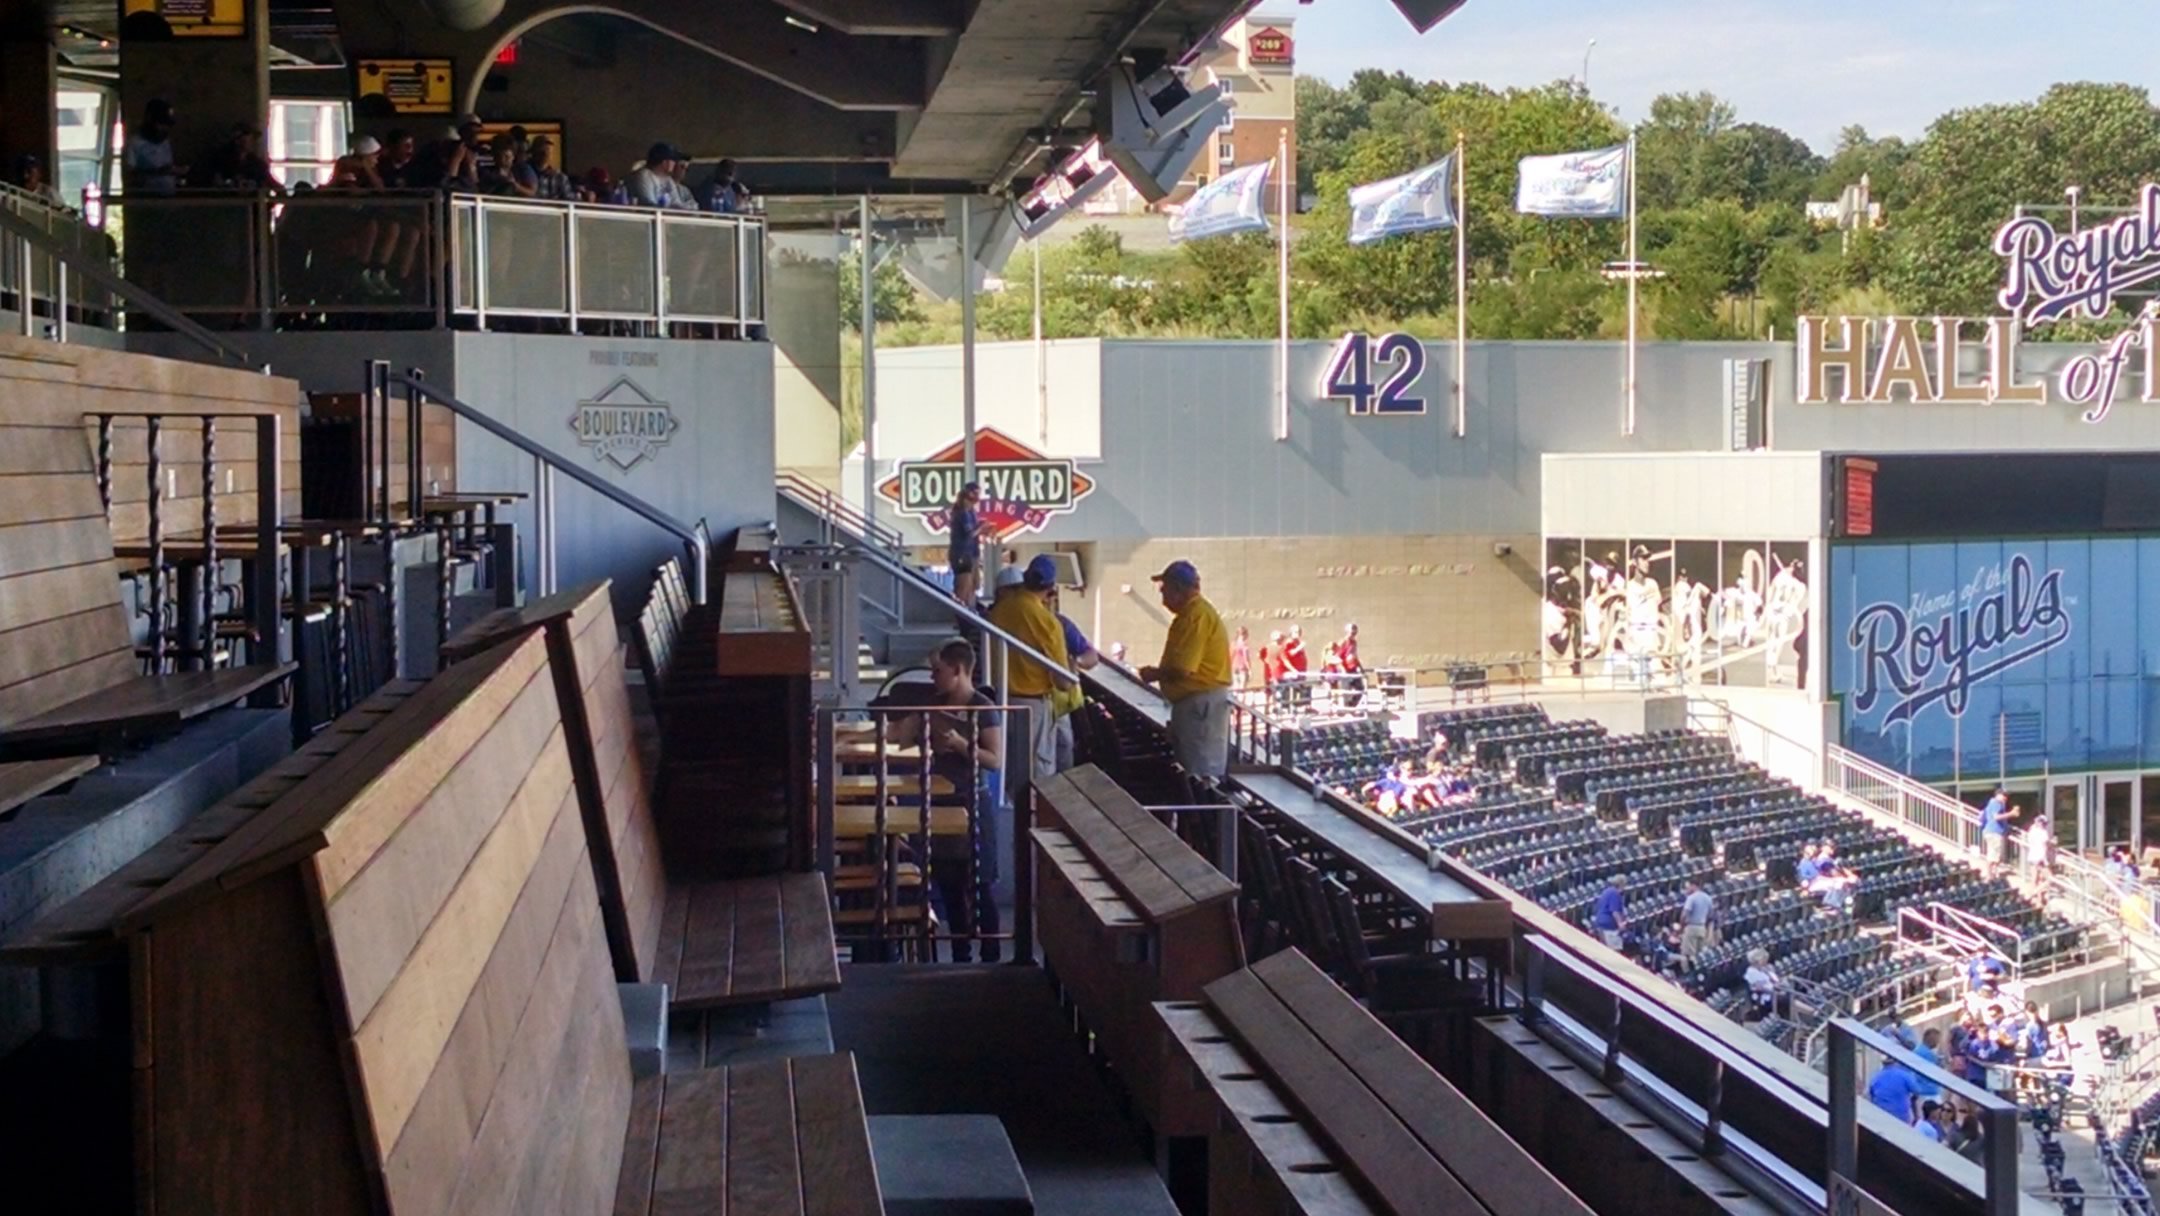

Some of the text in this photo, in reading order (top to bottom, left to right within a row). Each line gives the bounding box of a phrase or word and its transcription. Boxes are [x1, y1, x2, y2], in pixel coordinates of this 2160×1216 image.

[1320, 332, 1426, 415] 42
[1797, 315, 2046, 405] HALL
[2060, 330, 2142, 422] of
[583, 410, 666, 437] BOULEVARD
[908, 468, 1065, 505] BOUEVARD
[1910, 590, 1956, 619] Home
[1960, 566, 1985, 601] of
[1848, 553, 2070, 738] Royals
